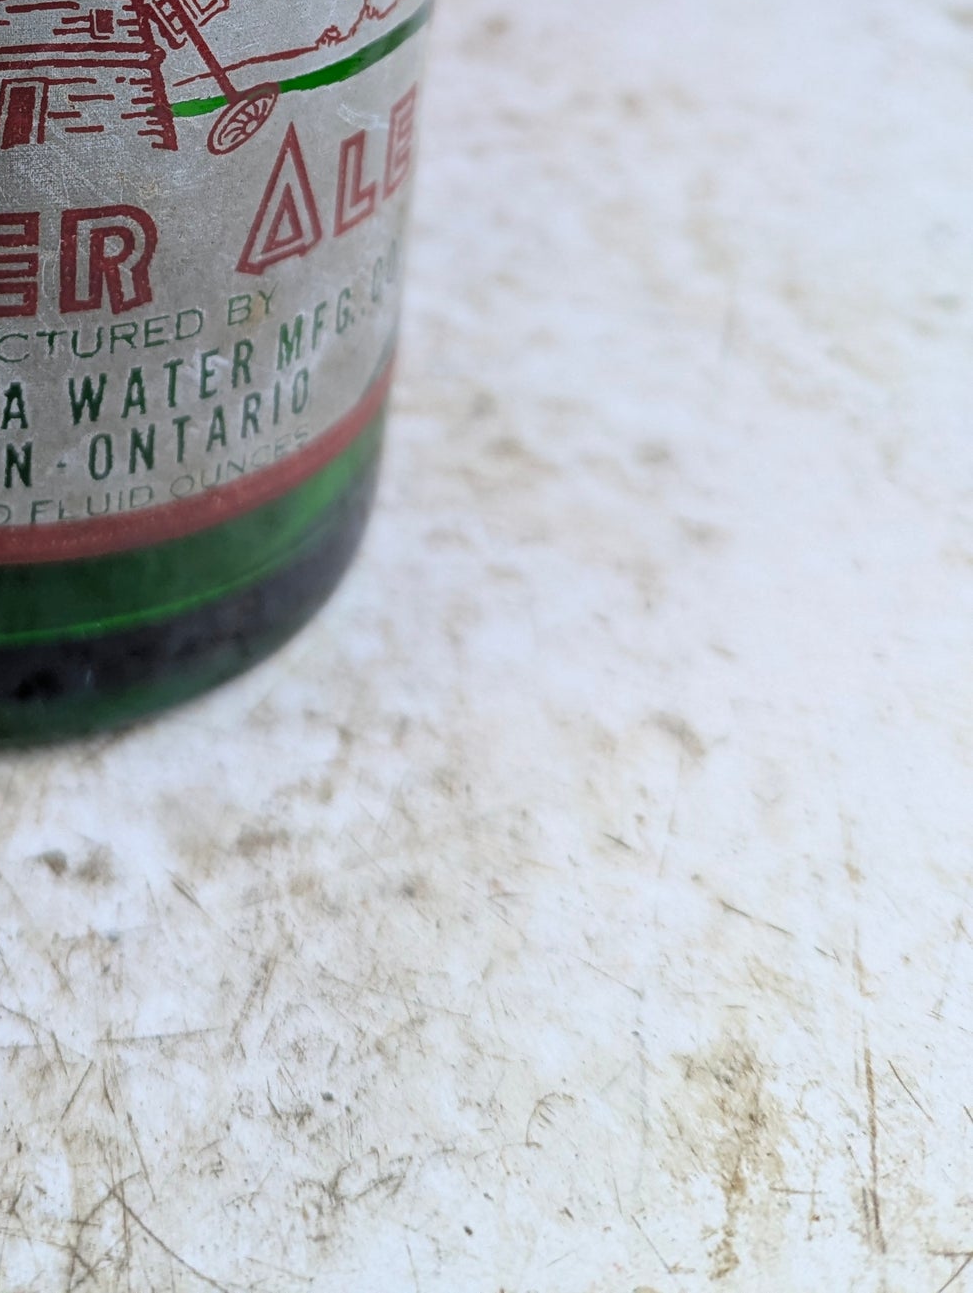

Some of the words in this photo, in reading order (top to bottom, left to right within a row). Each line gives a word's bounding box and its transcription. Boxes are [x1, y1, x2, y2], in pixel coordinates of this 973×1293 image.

[235, 81, 419, 276] ALE
[226, 284, 278, 327] BY
[67, 338, 254, 426] WATER
[87, 368, 311, 482] ONTARIO
[29, 485, 155, 525] FLUID
